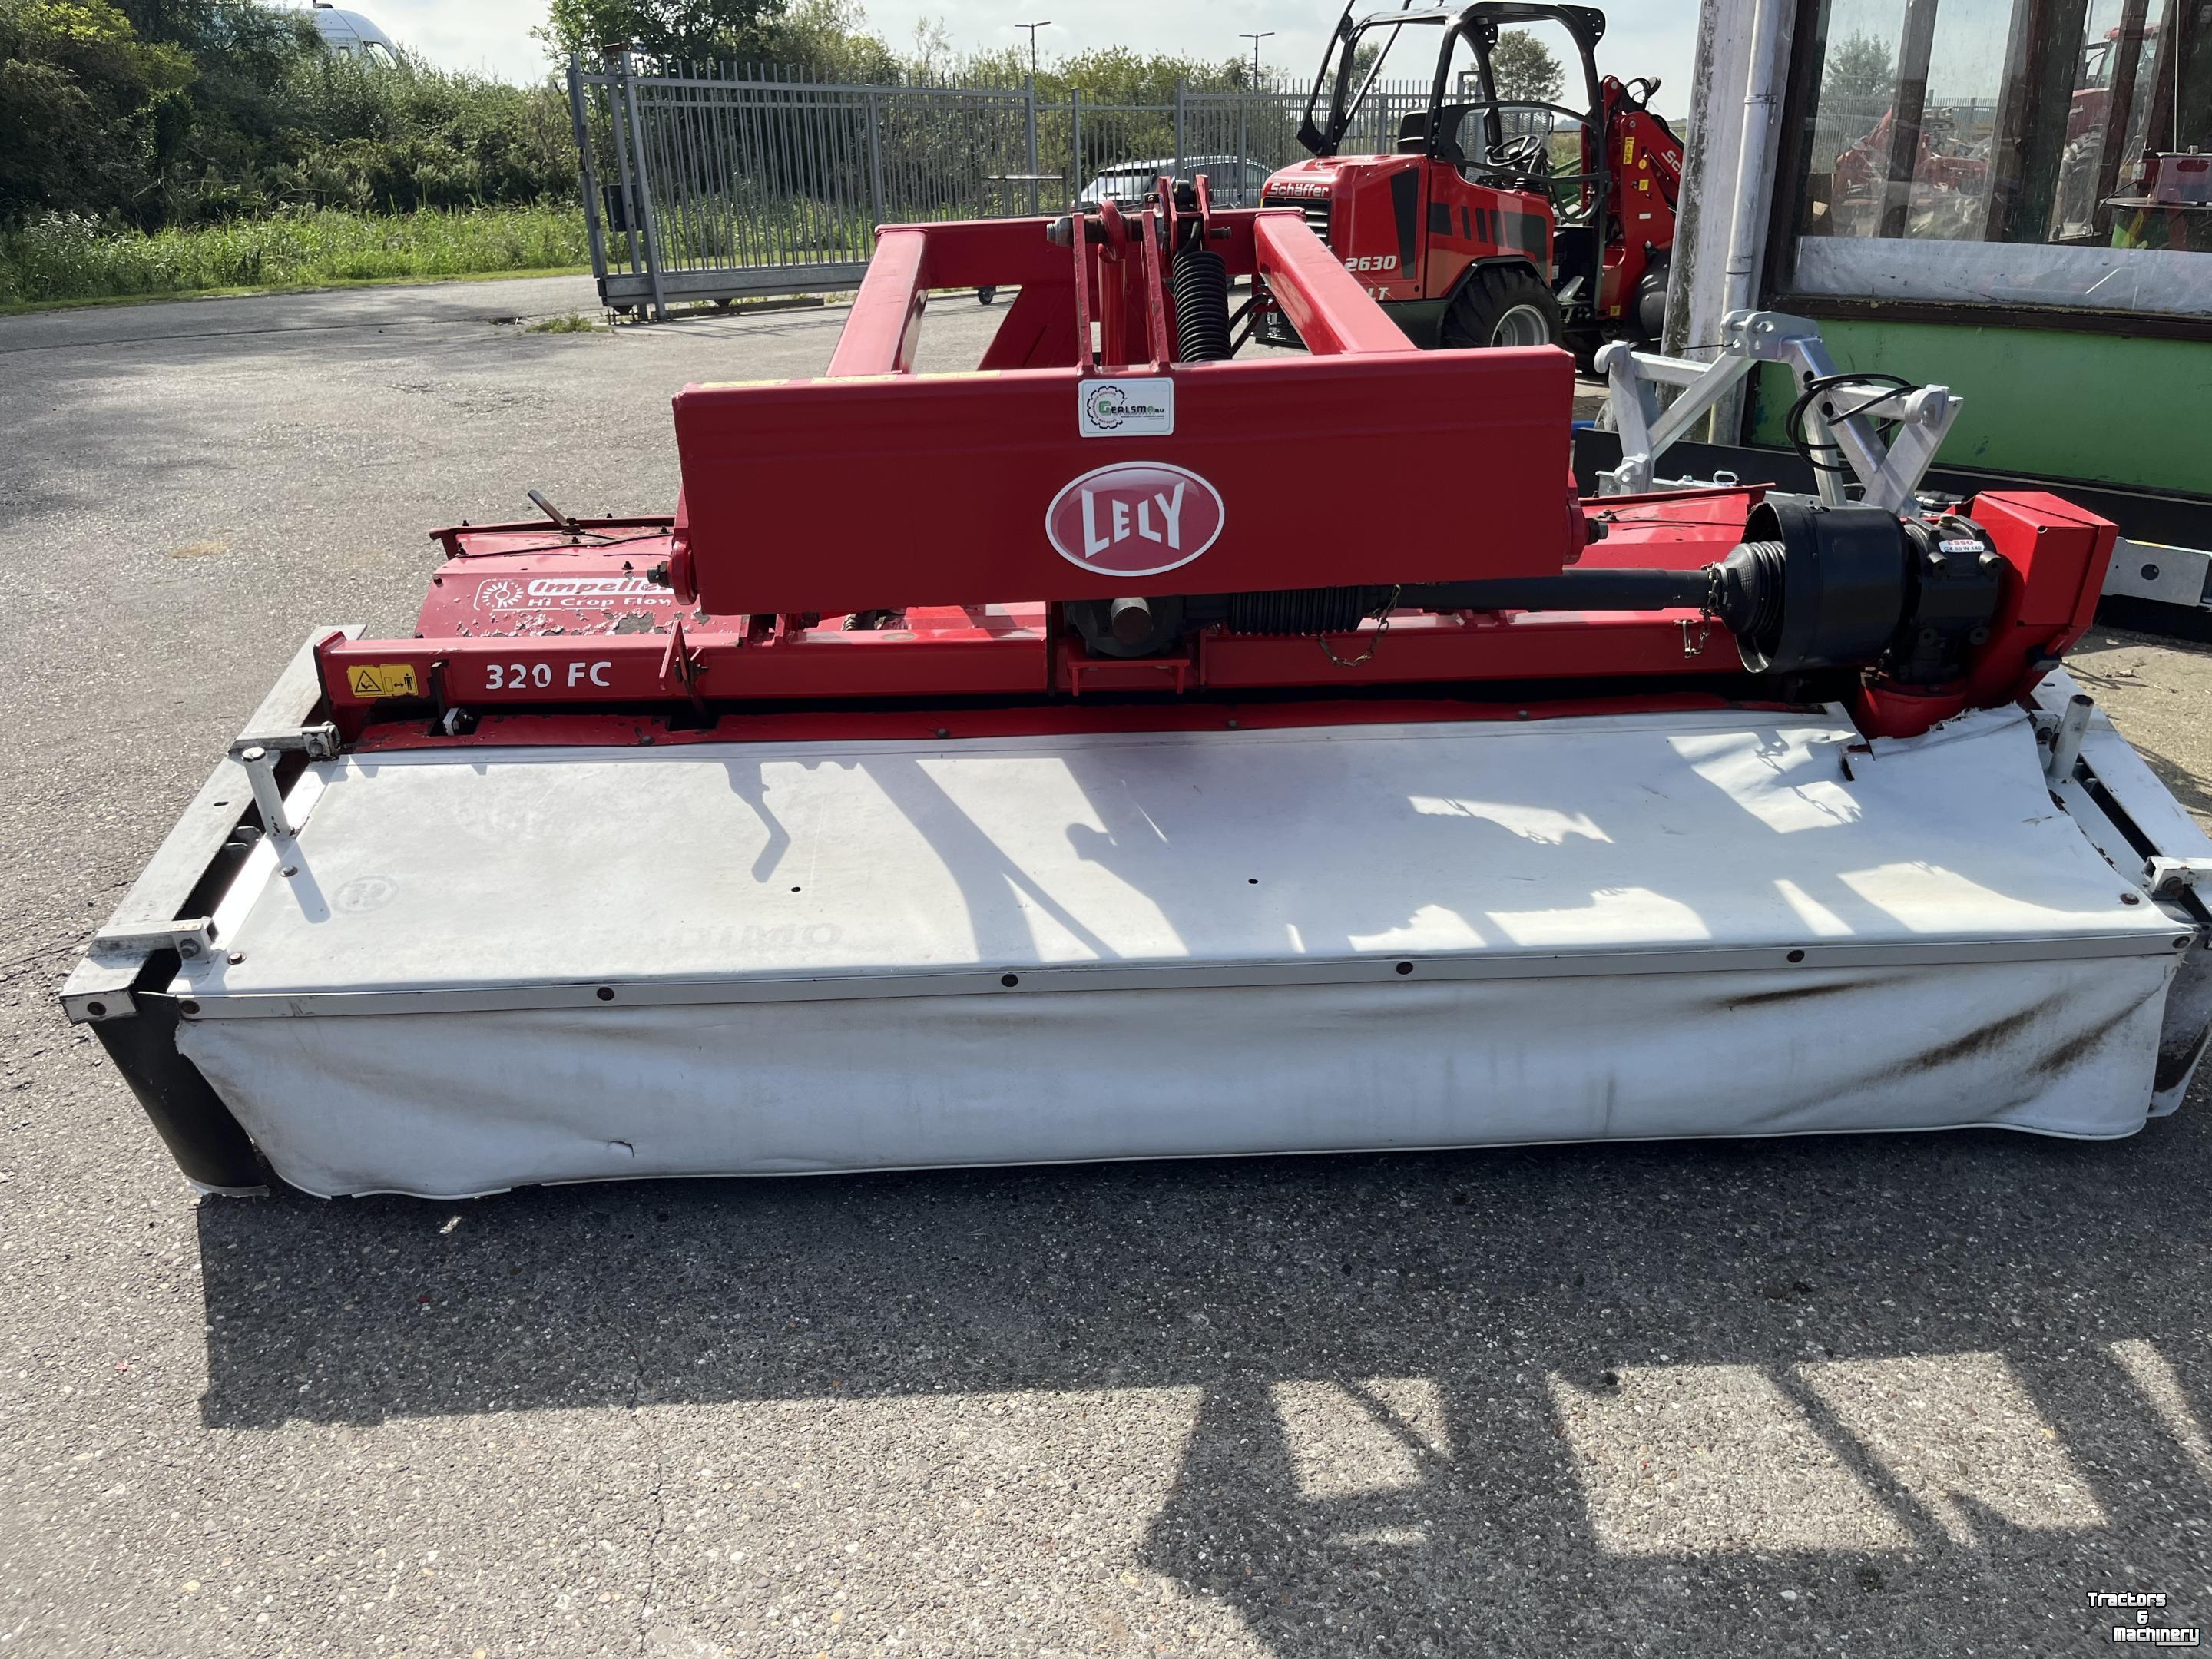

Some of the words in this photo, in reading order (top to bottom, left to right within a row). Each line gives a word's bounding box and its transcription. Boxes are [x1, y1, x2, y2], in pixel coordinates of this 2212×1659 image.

[1267, 183, 1330, 197] Schäffer
[1344, 255, 1397, 272] 2630
[1081, 481, 1185, 559] LELY
[528, 598, 551, 607] Hi
[560, 598, 614, 608] Crop
[485, 663, 551, 690] 320
[567, 661, 611, 687] FC
